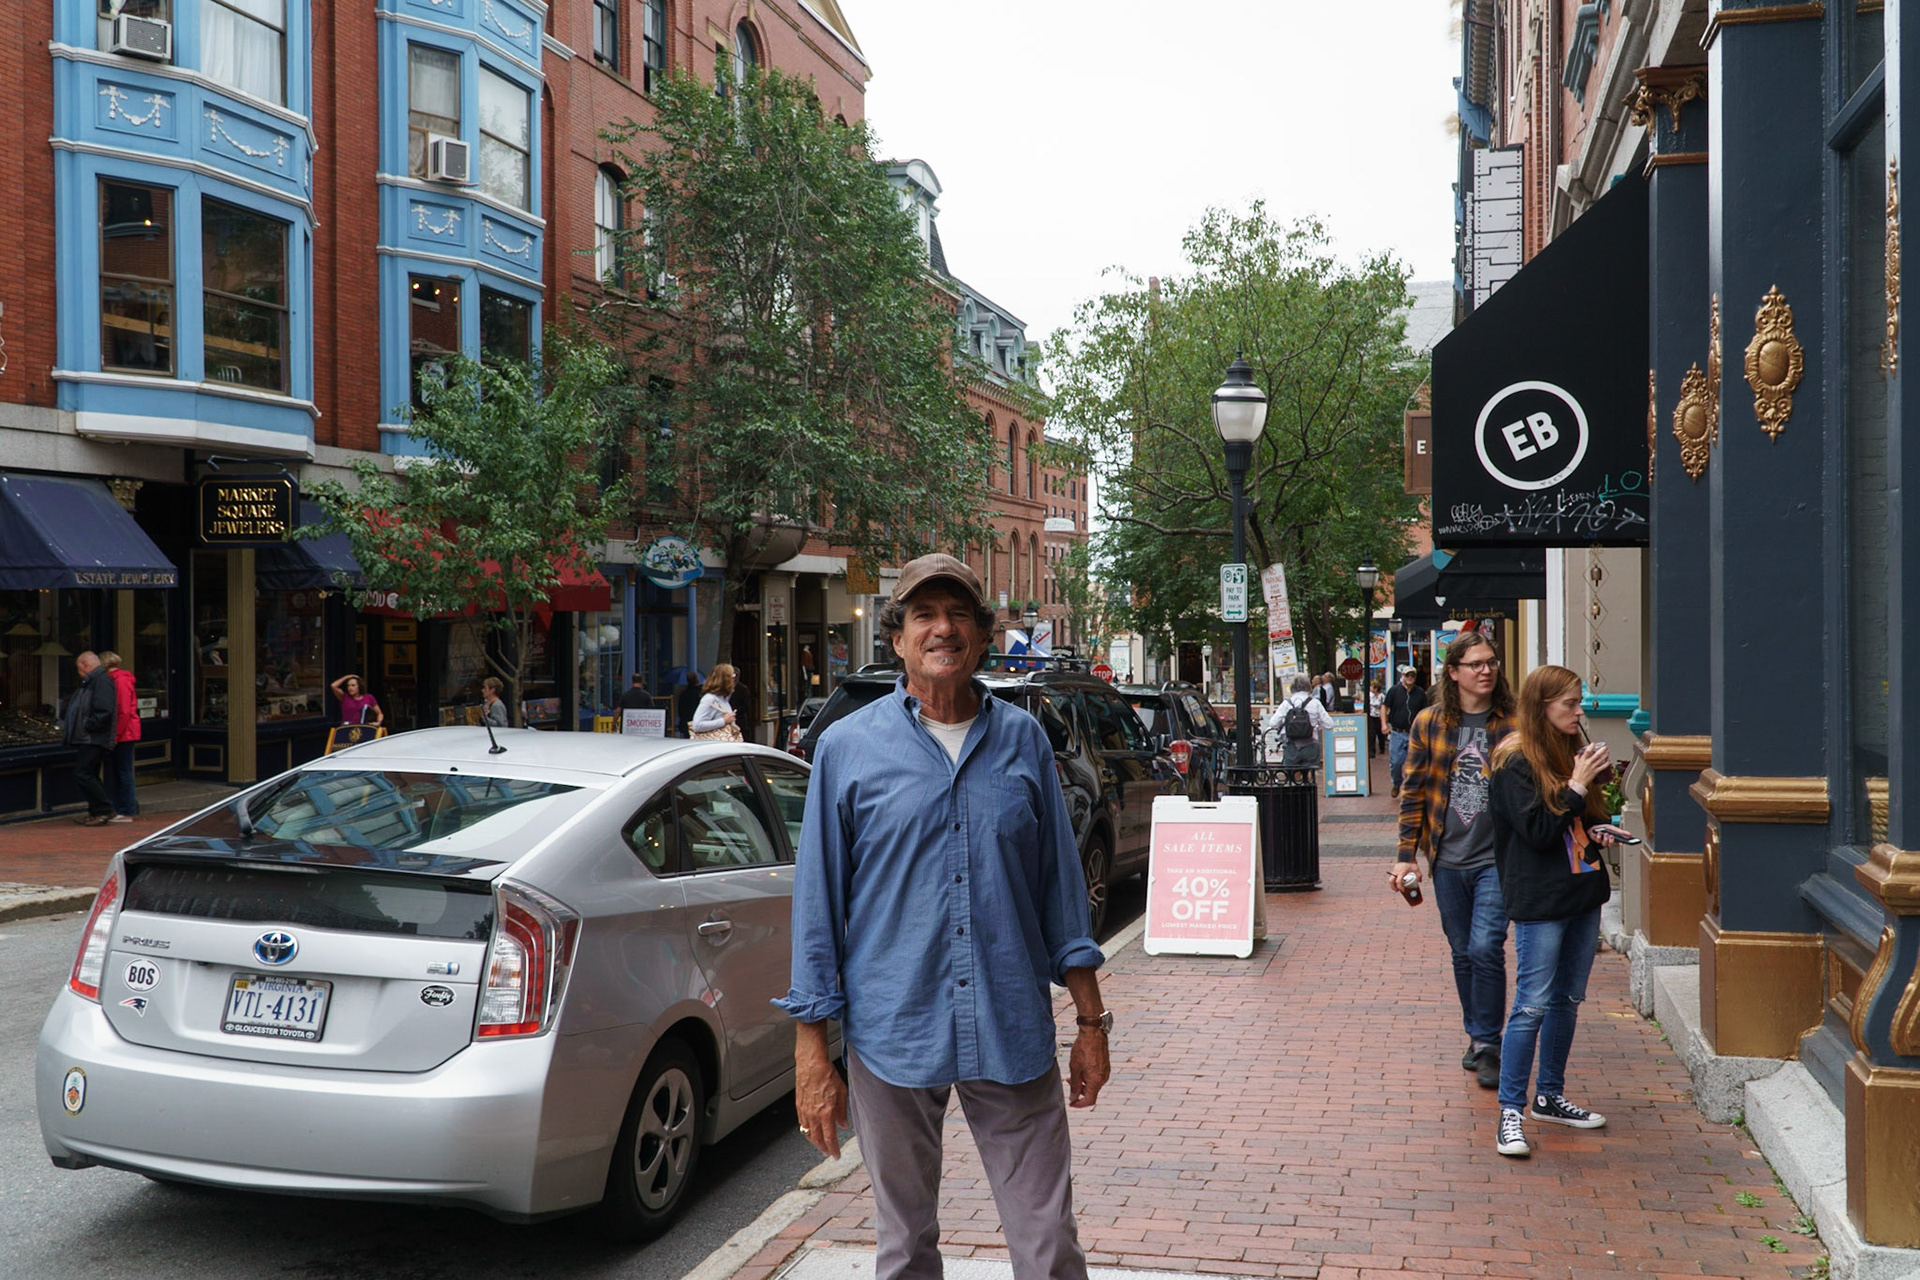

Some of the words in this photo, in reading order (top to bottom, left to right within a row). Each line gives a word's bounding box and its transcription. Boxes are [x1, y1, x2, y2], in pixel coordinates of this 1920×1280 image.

[1464, 192, 1474, 246] Photography
[1464, 248, 1473, 272] Stuart
[1464, 274, 1473, 290] Paul
[1501, 411, 1559, 462] EB
[218, 488, 277, 501] MARKET
[217, 505, 277, 519] SQUARE
[209, 521, 285, 535] JEWELERS
[75, 573, 116, 585] ESTATE
[119, 573, 175, 585] JEWELERY
[1473, 607, 1505, 620] jewelers
[1094, 671, 1112, 679] STOP
[1341, 665, 1361, 674] STOP
[626, 719, 662, 728] SMOOTHIES
[1332, 725, 1358, 733] jewelers
[1191, 831, 1215, 841] ALL
[1163, 843, 1195, 853] SALE
[1201, 843, 1243, 853] ITEMS
[1172, 876, 1230, 898] 40%
[1172, 900, 1229, 921] OFF
[128, 966, 155, 985] BOS
[258, 981, 304, 993] VIRGINIA
[233, 989, 318, 1024] VTL-4131
[235, 1024, 279, 1035] GLOUCESTER
[280, 1028, 305, 1038] TOYOTA
